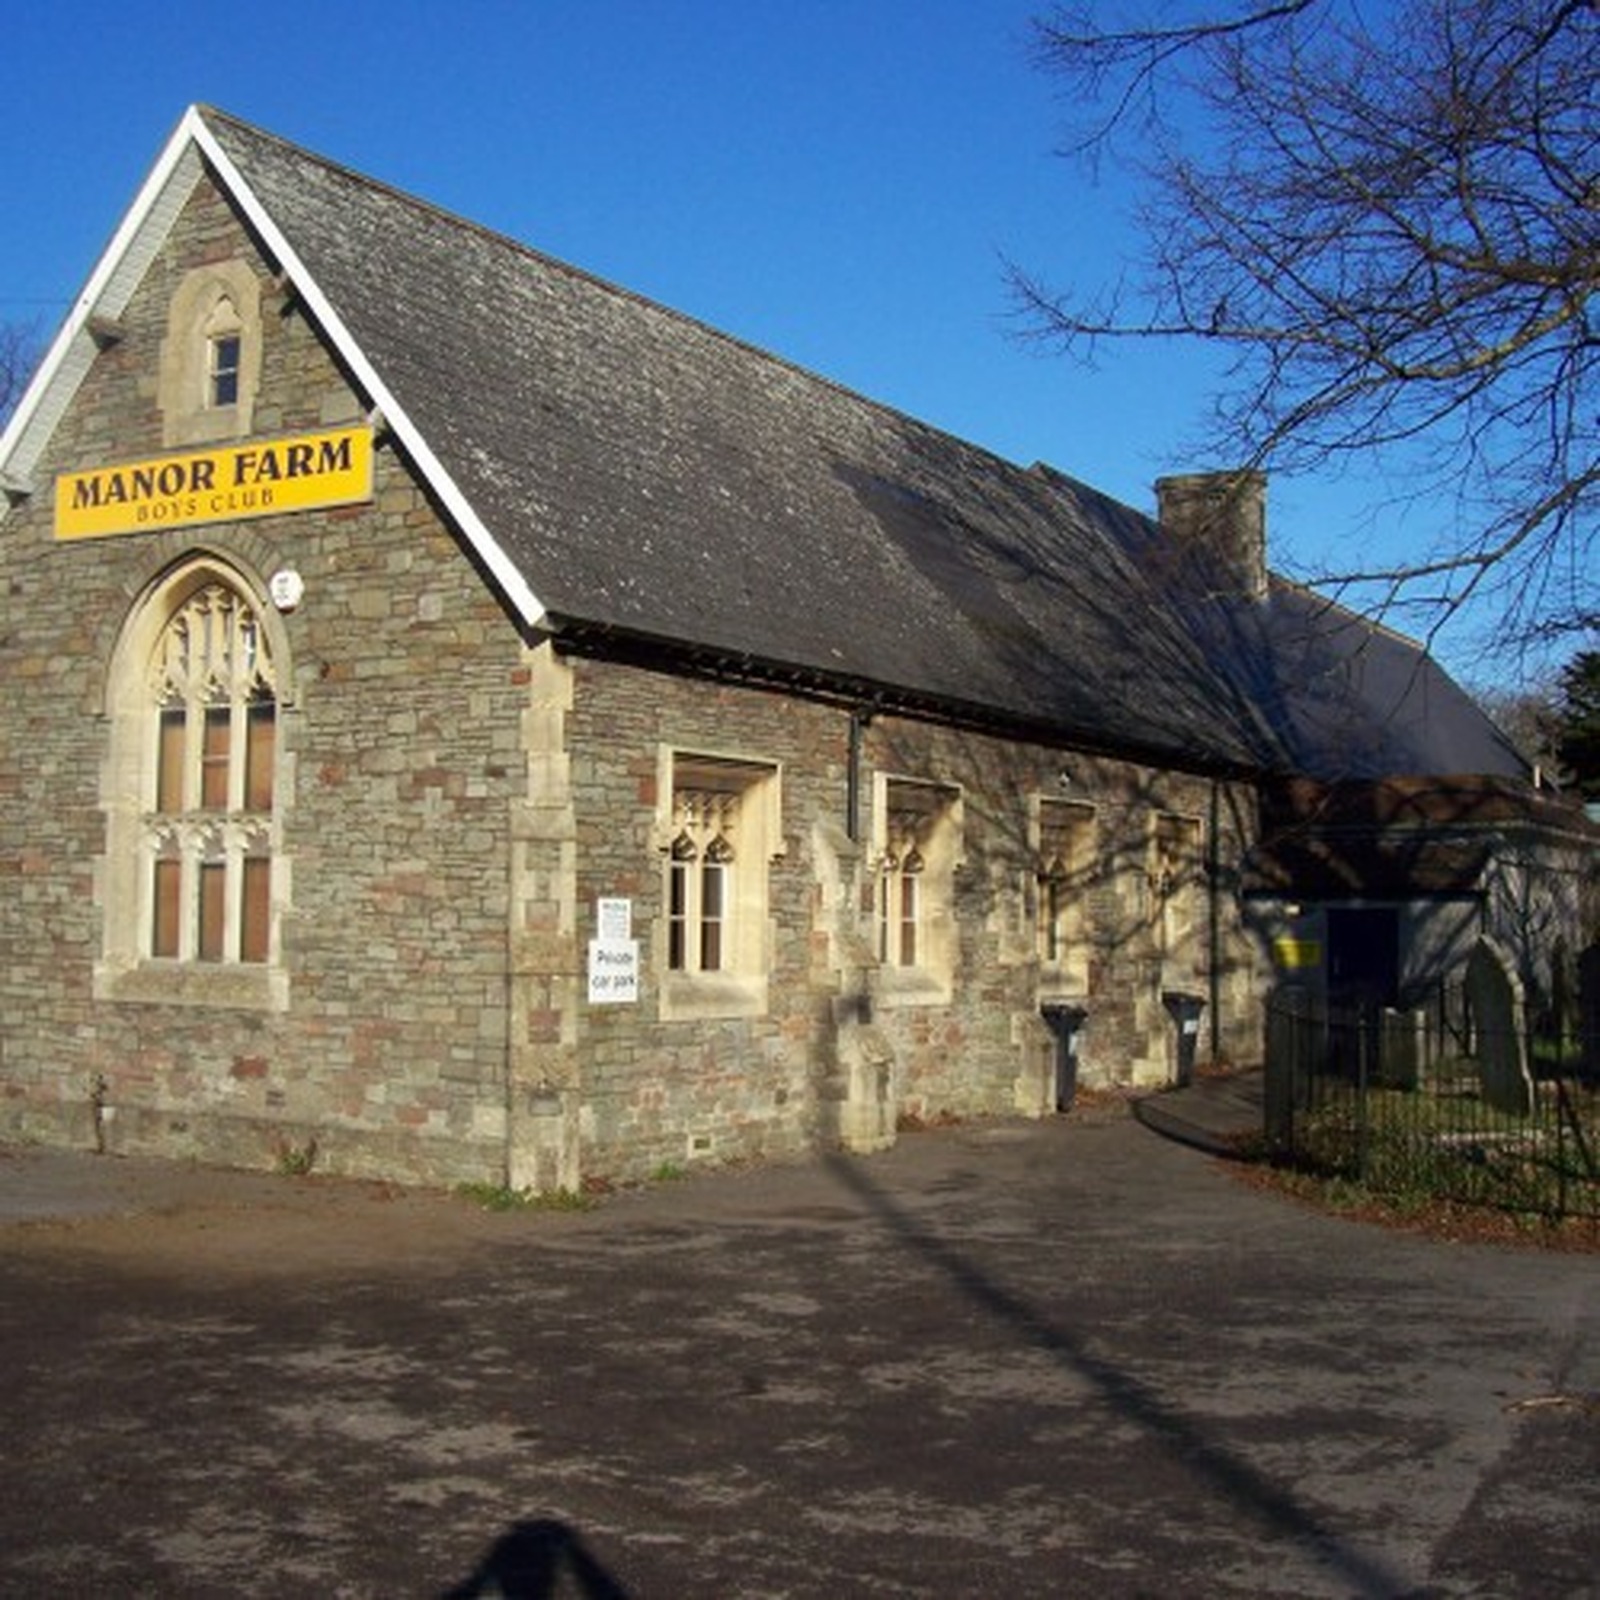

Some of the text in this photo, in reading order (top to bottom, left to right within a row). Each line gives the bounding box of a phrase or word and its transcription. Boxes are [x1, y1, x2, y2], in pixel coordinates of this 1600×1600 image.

[72, 438, 352, 509] MANOR FARM
[137, 489, 274, 522] BOYS CLUB
